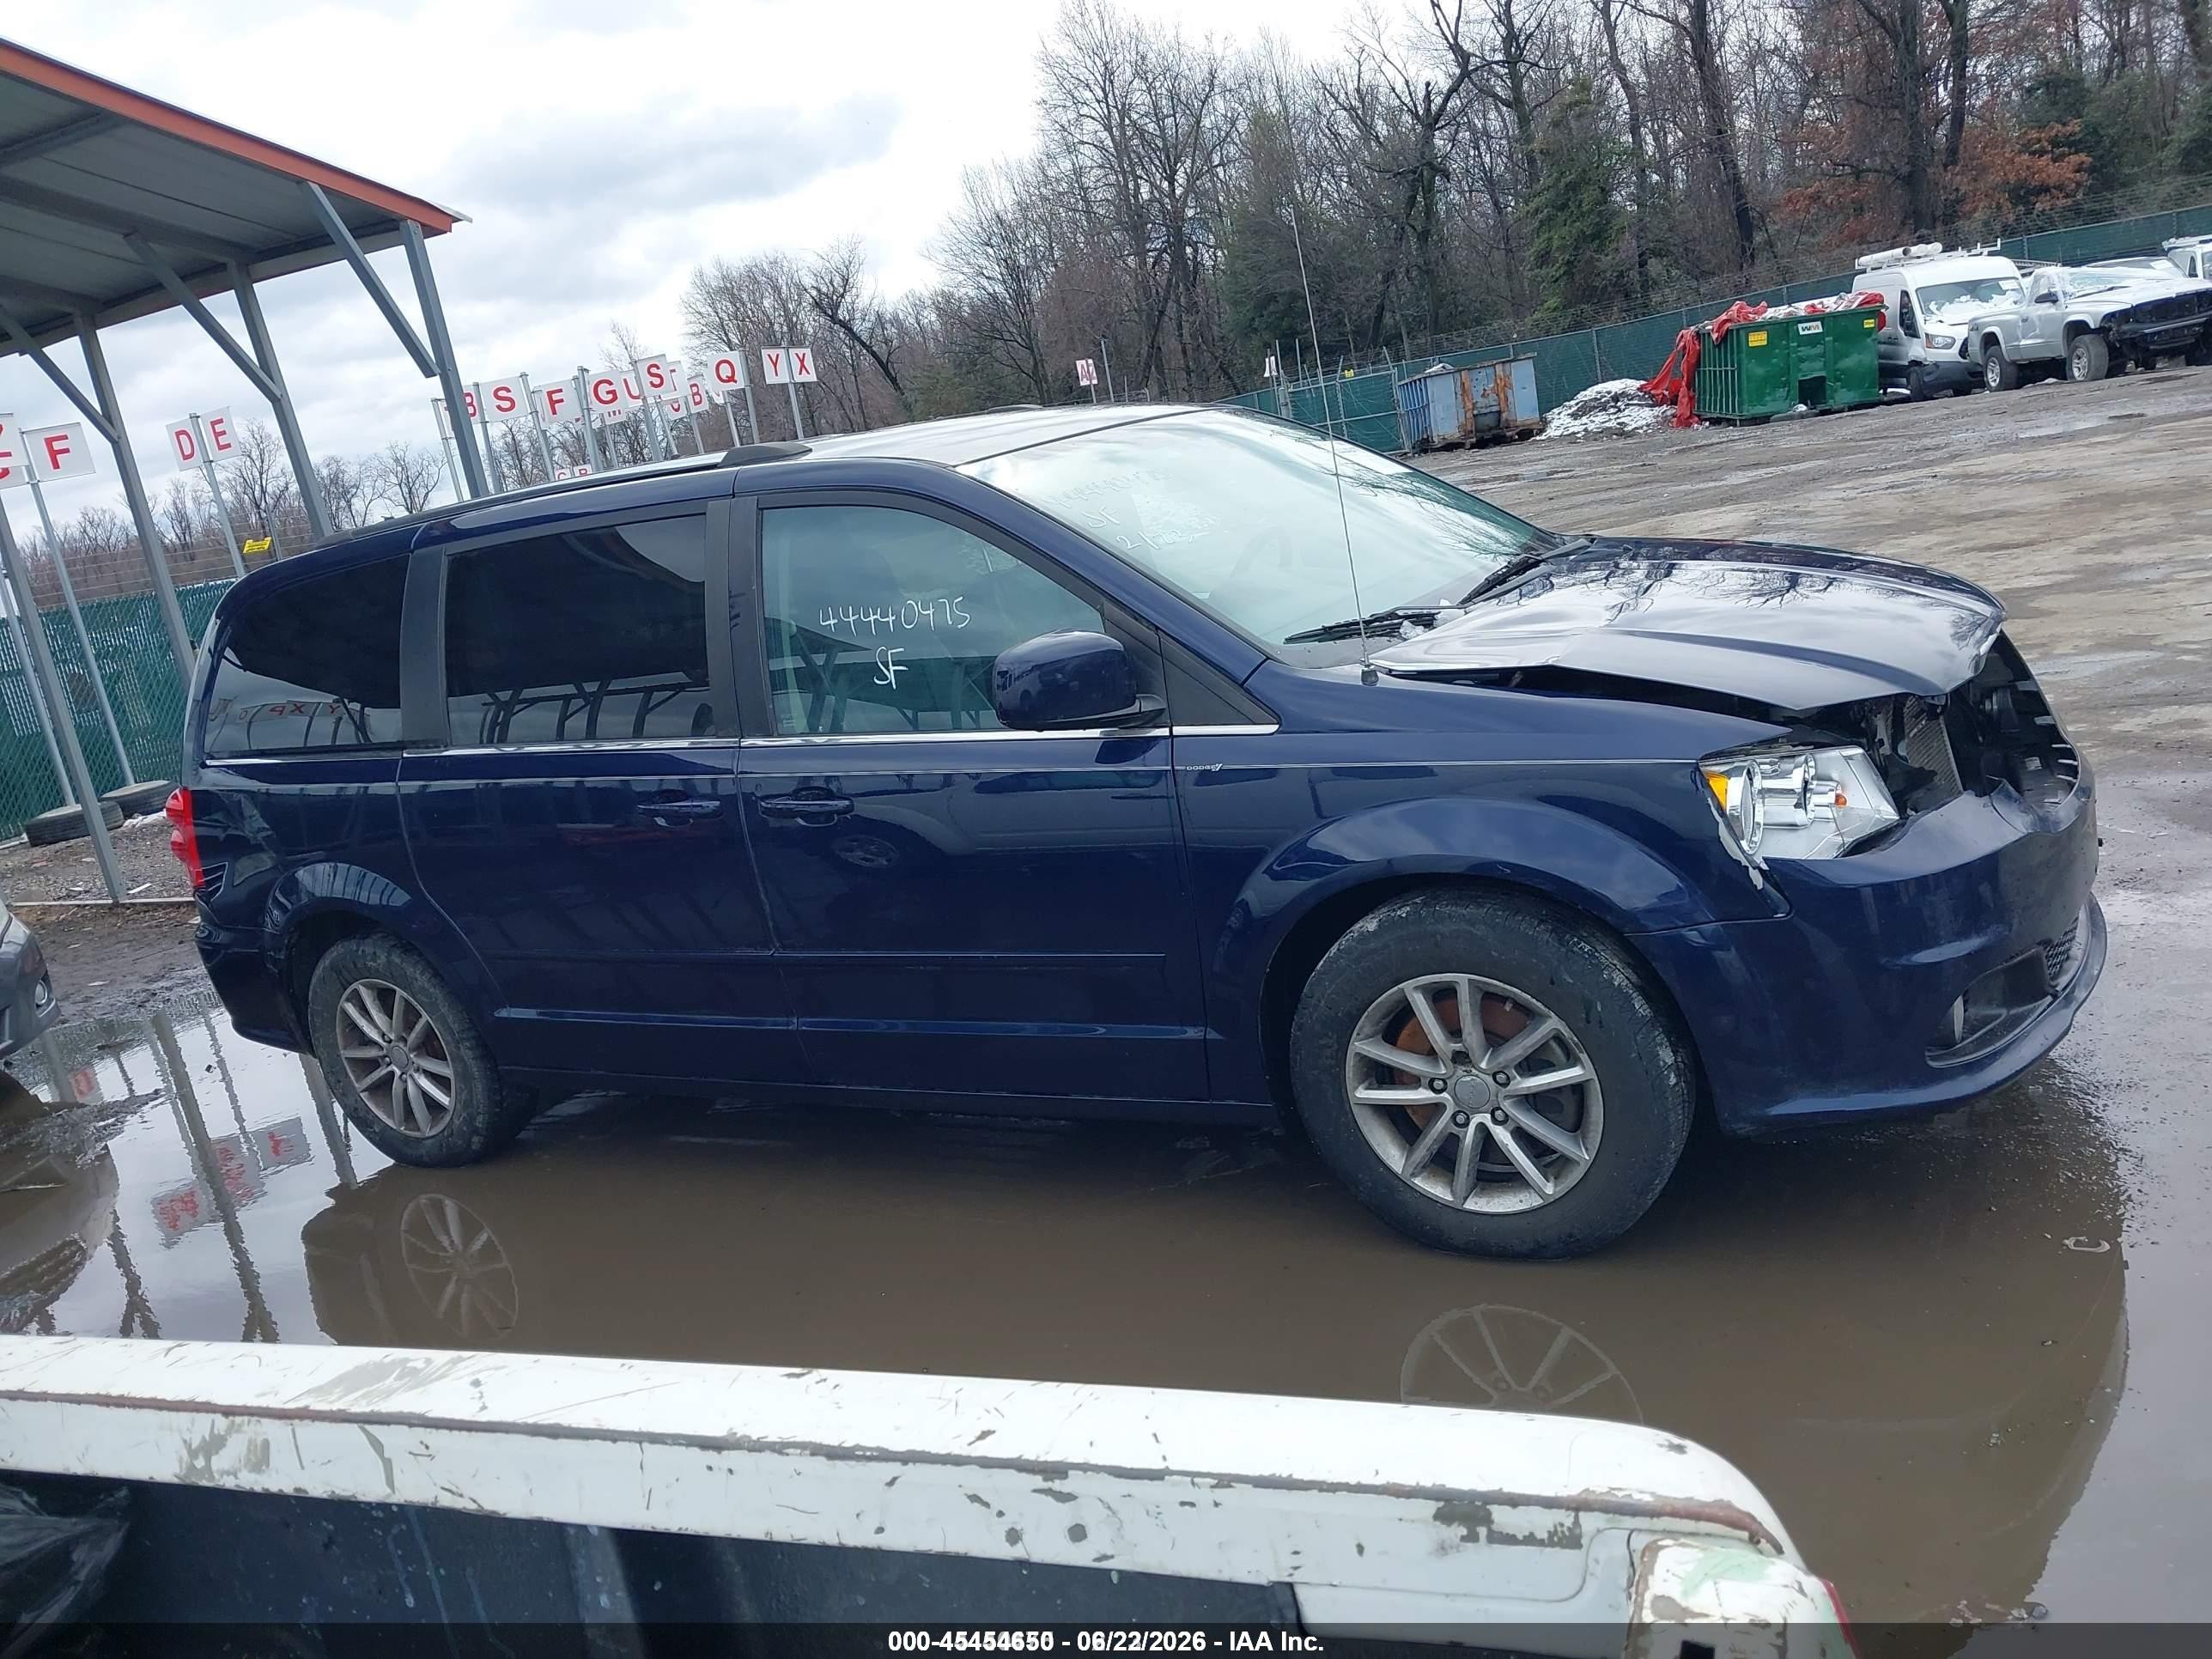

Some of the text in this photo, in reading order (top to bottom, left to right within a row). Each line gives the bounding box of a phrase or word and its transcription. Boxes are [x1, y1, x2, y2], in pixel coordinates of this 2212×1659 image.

[647, 363, 665, 388] S
[715, 359, 738, 384] Q
[767, 353, 780, 377] Y
[794, 352, 811, 376] X
[492, 386, 516, 412] S
[546, 388, 565, 416] F
[592, 379, 618, 404] G
[690, 383, 702, 406] B
[174, 429, 195, 461] D
[210, 417, 232, 451] E
[44, 434, 71, 471] F
[819, 596, 972, 637] 44440475
[873, 646, 908, 690] SF
